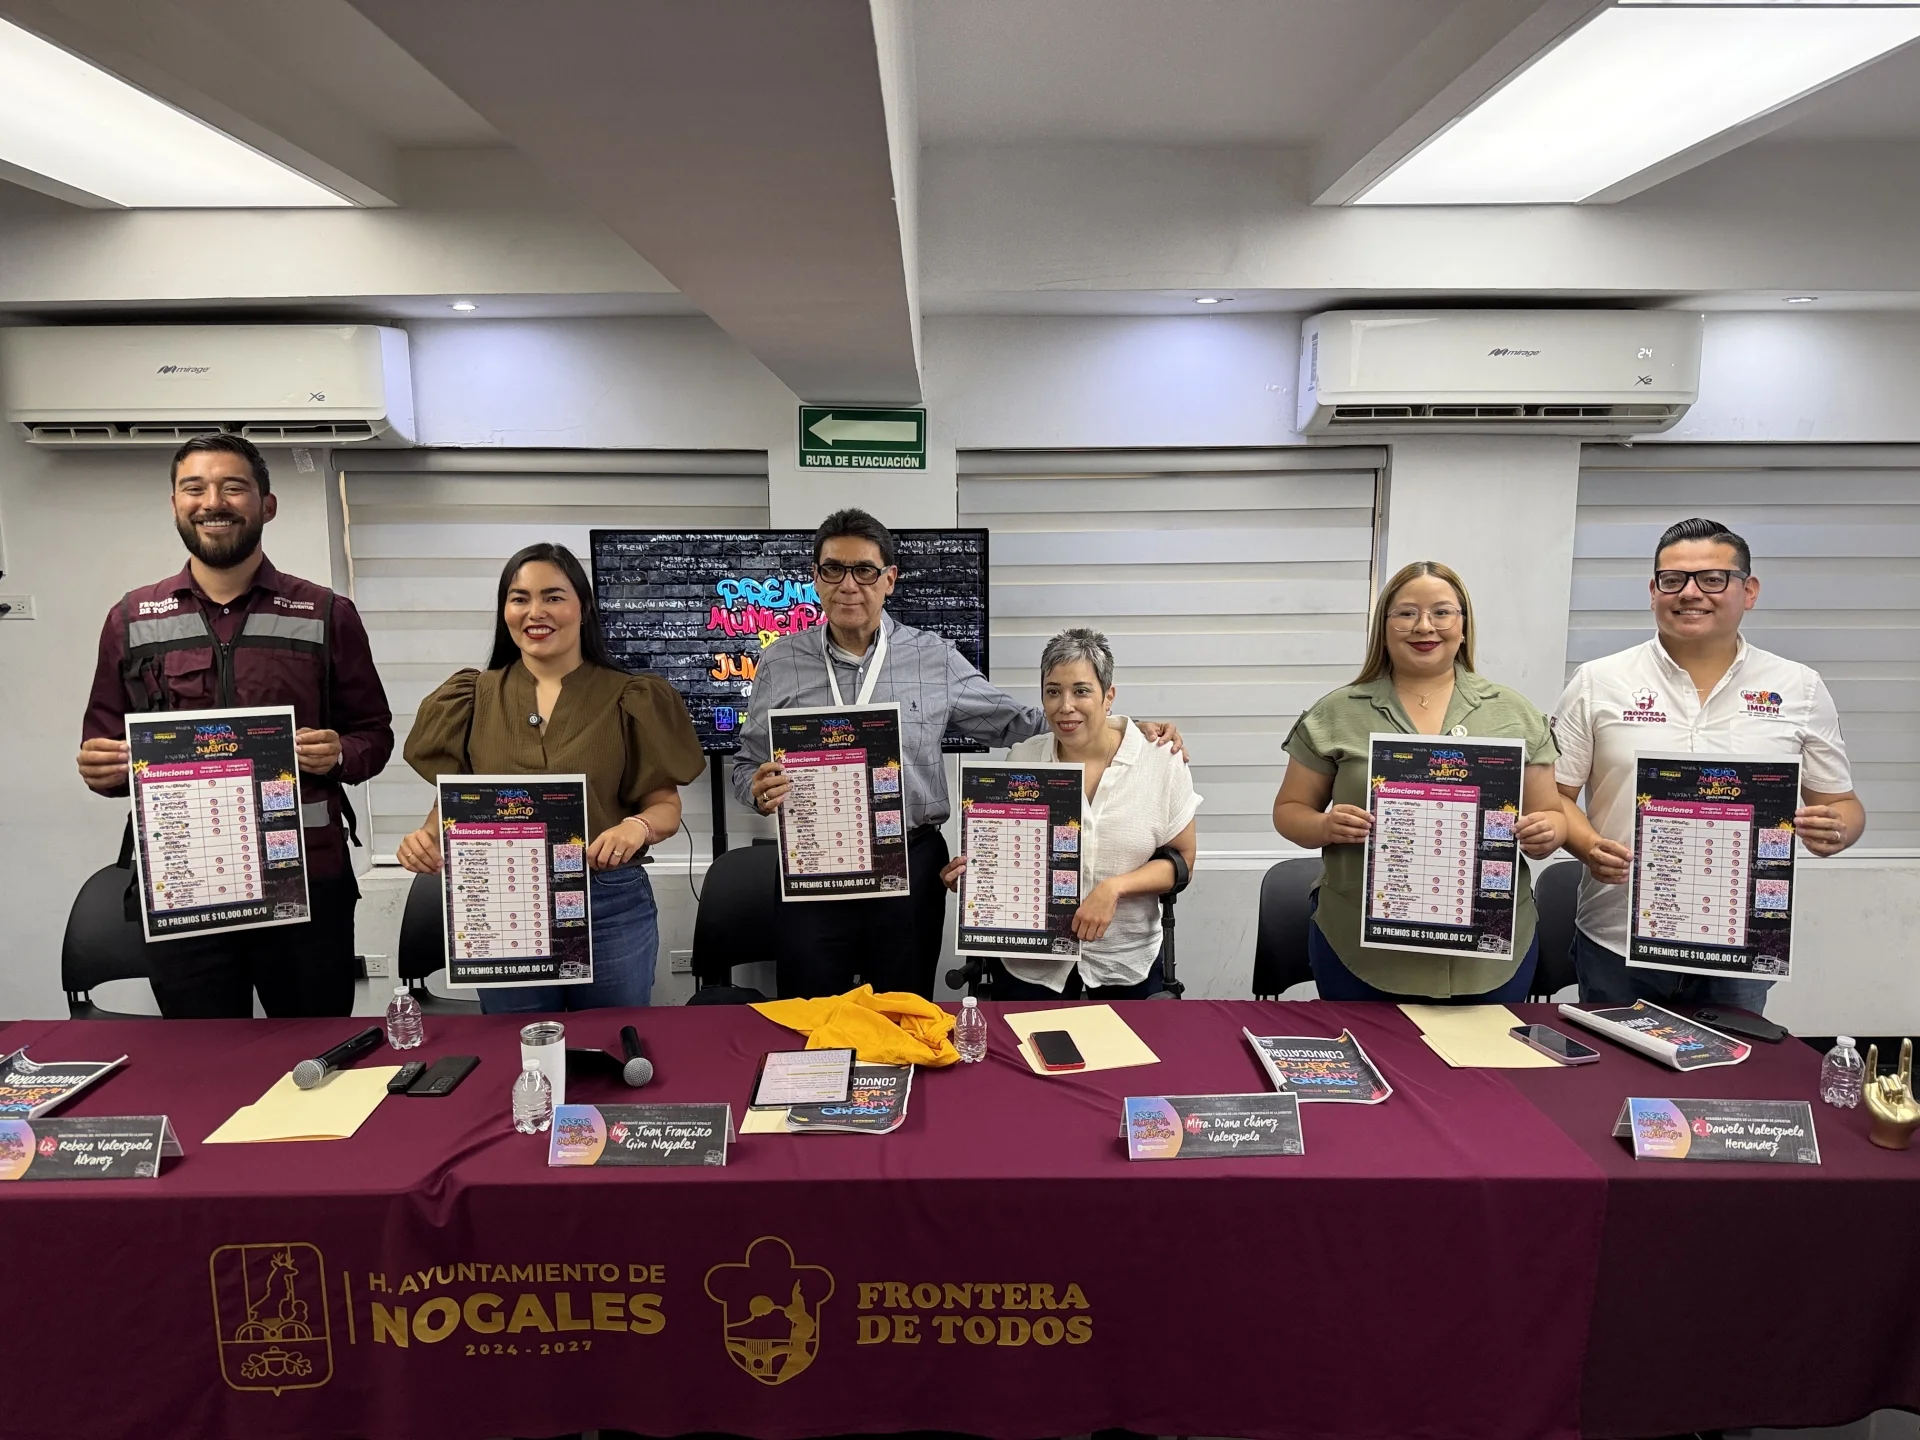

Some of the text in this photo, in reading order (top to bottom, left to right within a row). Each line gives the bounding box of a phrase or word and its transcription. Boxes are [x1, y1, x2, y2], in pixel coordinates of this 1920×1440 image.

[1508, 349, 1540, 357] mirage
[1638, 348, 1652, 358] 24
[806, 455, 919, 467] RUTA DE EVACUACIÓN
[1747, 705, 1779, 714] IMDEN
[143, 768, 194, 778] Distinciones
[1379, 786, 1425, 796] Distinciones
[1645, 804, 1693, 814] Distinciones
[157, 919, 167, 927] 20
[169, 916, 199, 926] PREMIOS
[201, 915, 211, 923] DE
[973, 935, 996, 943] PREMIOS
[1373, 927, 1382, 935] 20
[1383, 928, 1410, 937] PREMIOS
[1412, 929, 1420, 937] DE
[1639, 945, 1648, 953] 20
[1649, 948, 1678, 956] PREMIOS
[1680, 950, 1689, 958] DE
[458, 967, 466, 975] 20
[467, 967, 493, 975] PREMIOS
[1187, 1115, 1278, 1132] Mtra. Diana Chávez
[612, 1125, 712, 1143] Ing. Juan Francisco
[1693, 1123, 1804, 1141] C. Daniela Valenzuela
[1208, 1132, 1260, 1147] Valenzuela
[39, 1139, 153, 1157] Lic. Rebeca Valenzuela
[652, 1139, 696, 1157] Nogales
[74, 1152, 113, 1171] Álvarez
[369, 1262, 666, 1295] H. AYUNTAMIENTO DE
[857, 1282, 1090, 1309] FRONTERA
[371, 1292, 666, 1348] NOGALES
[857, 1315, 1092, 1346] DE TODOS
[465, 1344, 518, 1356] 2024
[540, 1341, 592, 1354] 2027
